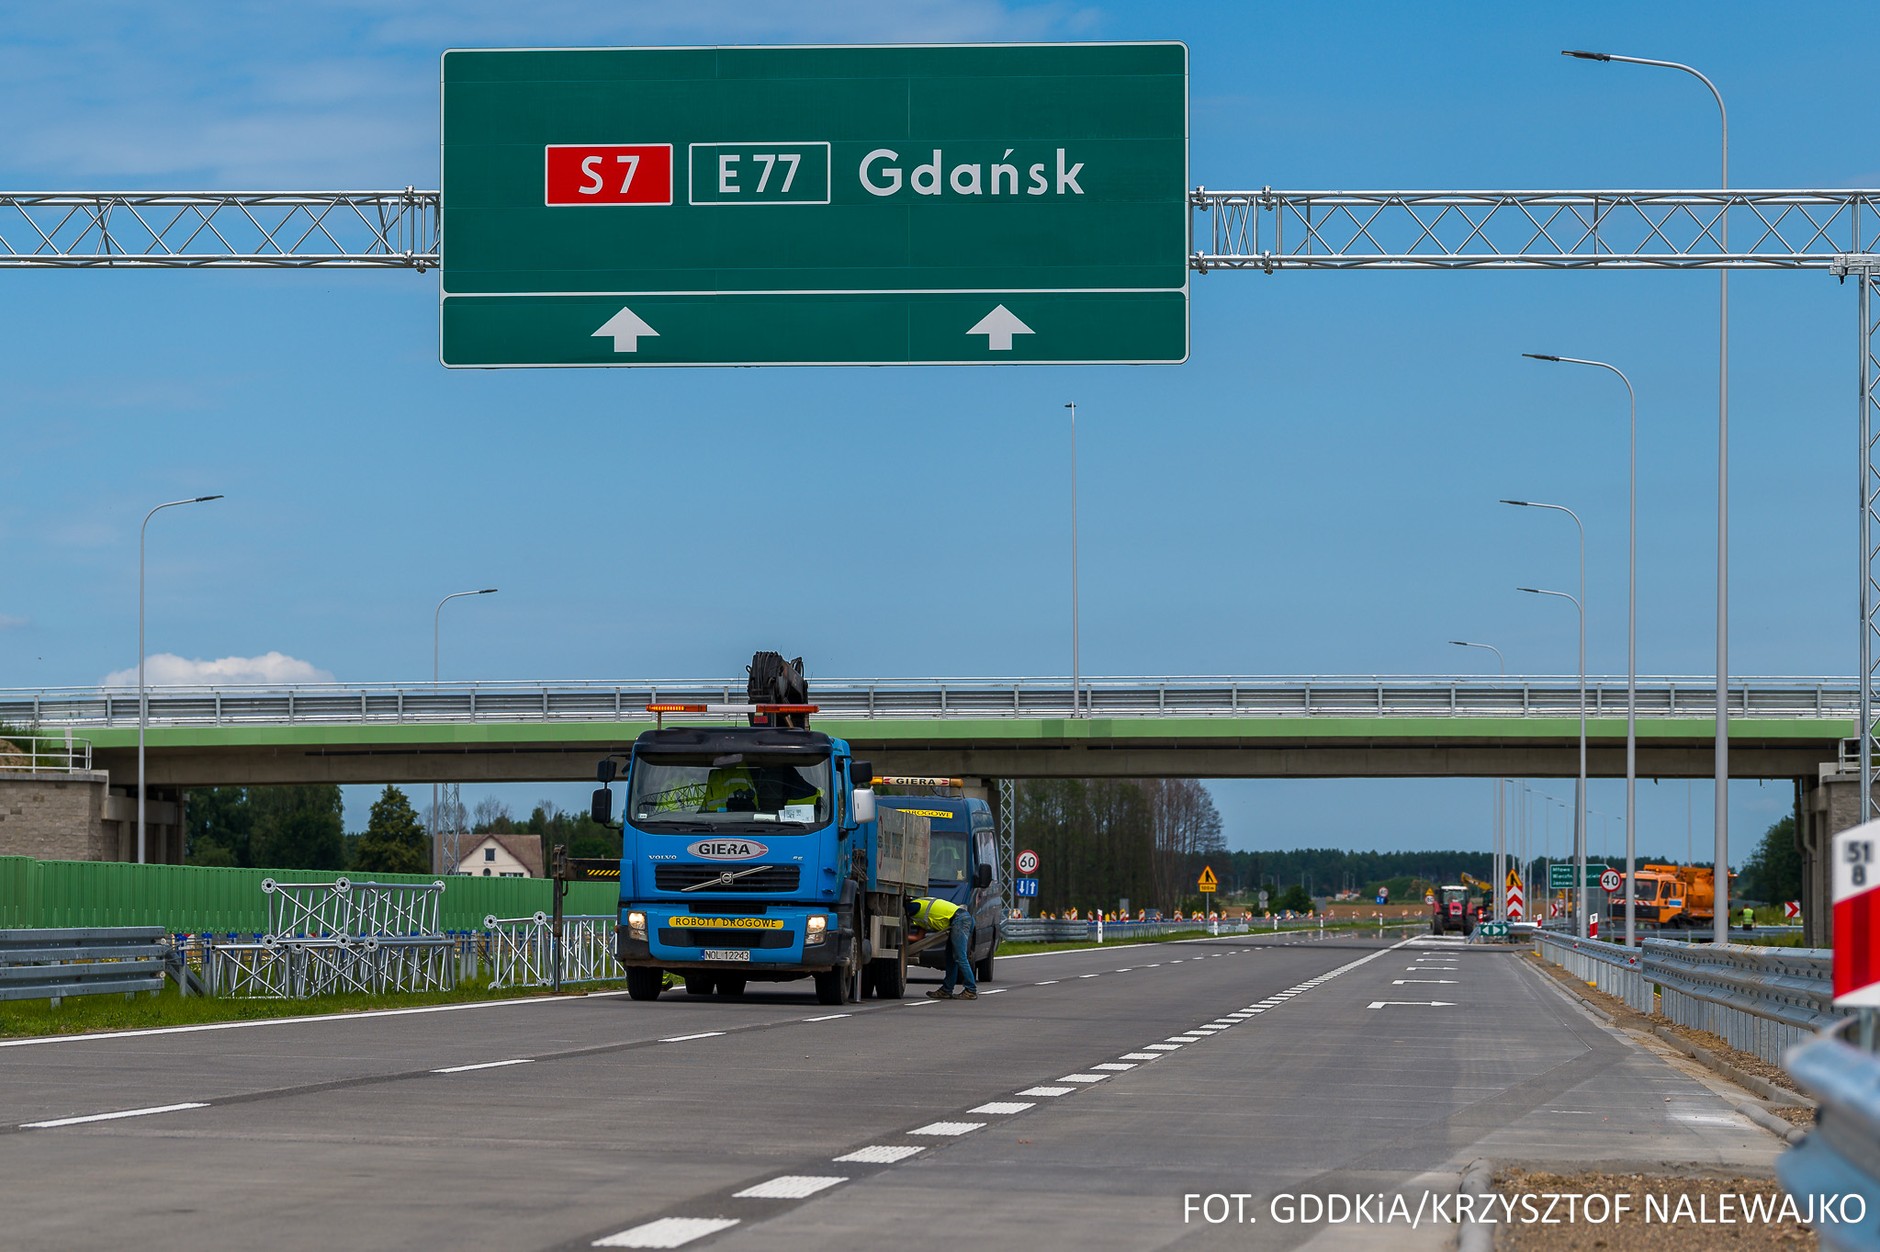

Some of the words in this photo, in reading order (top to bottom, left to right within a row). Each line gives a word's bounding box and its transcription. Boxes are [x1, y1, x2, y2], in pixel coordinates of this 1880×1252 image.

[578, 155, 604, 195] S
[616, 155, 641, 194] 7
[719, 154, 740, 193] E
[753, 154, 802, 193] 77
[859, 148, 1086, 197] Gdańsk
[698, 843, 751, 855] GIERA
[1844, 841, 1872, 864] 51
[1020, 856, 1035, 868] 60
[1602, 875, 1619, 887] 40
[1852, 864, 1867, 887] 8
[675, 917, 717, 927] ROBOTY
[722, 918, 776, 928] DROGOWE
[704, 950, 721, 960] NOL
[724, 950, 749, 960] 12243
